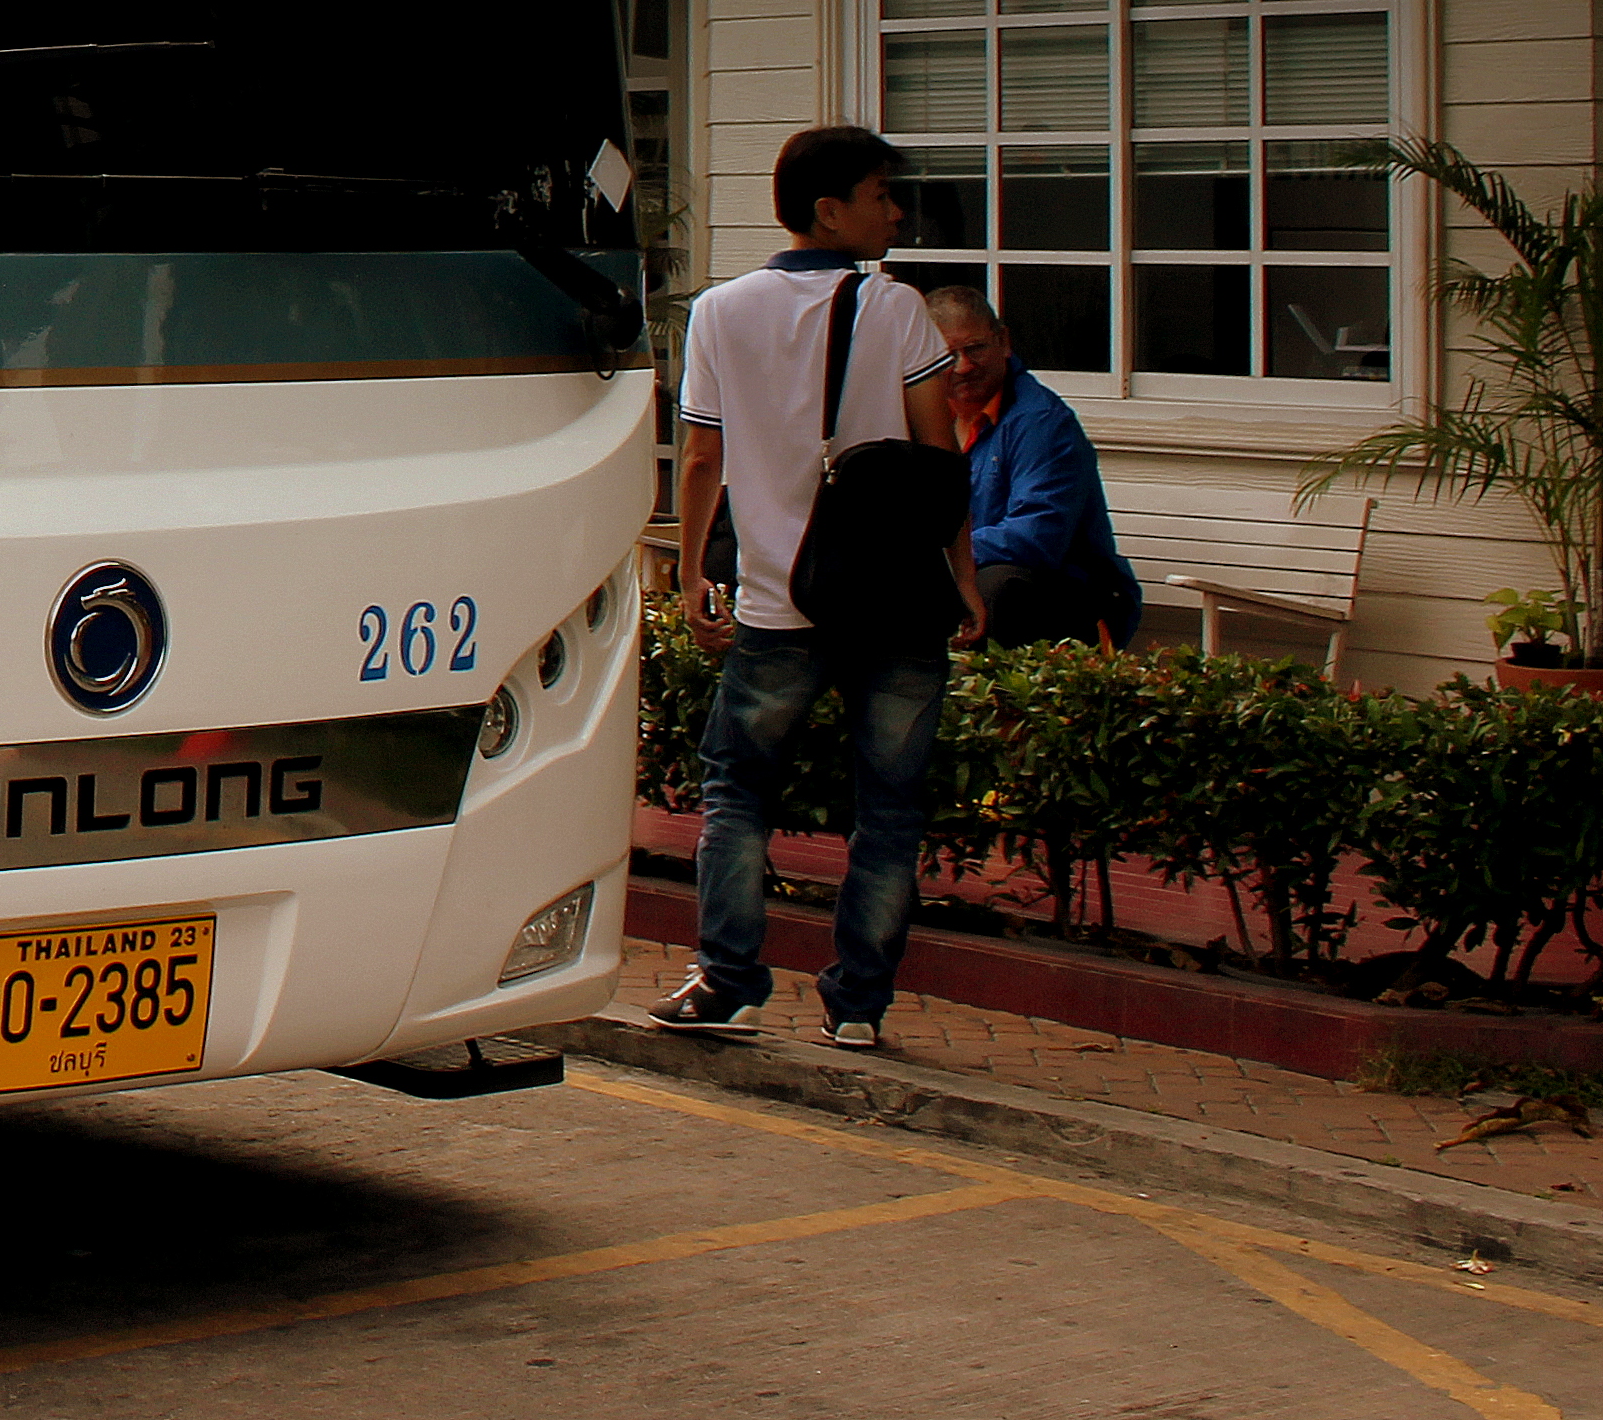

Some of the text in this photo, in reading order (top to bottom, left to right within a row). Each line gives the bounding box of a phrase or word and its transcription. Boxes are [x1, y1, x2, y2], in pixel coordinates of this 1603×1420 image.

[357, 594, 479, 682] 262
[16, 926, 197, 962] THAILAND 23
[49, 1041, 108, 1077] ชลบุรี
